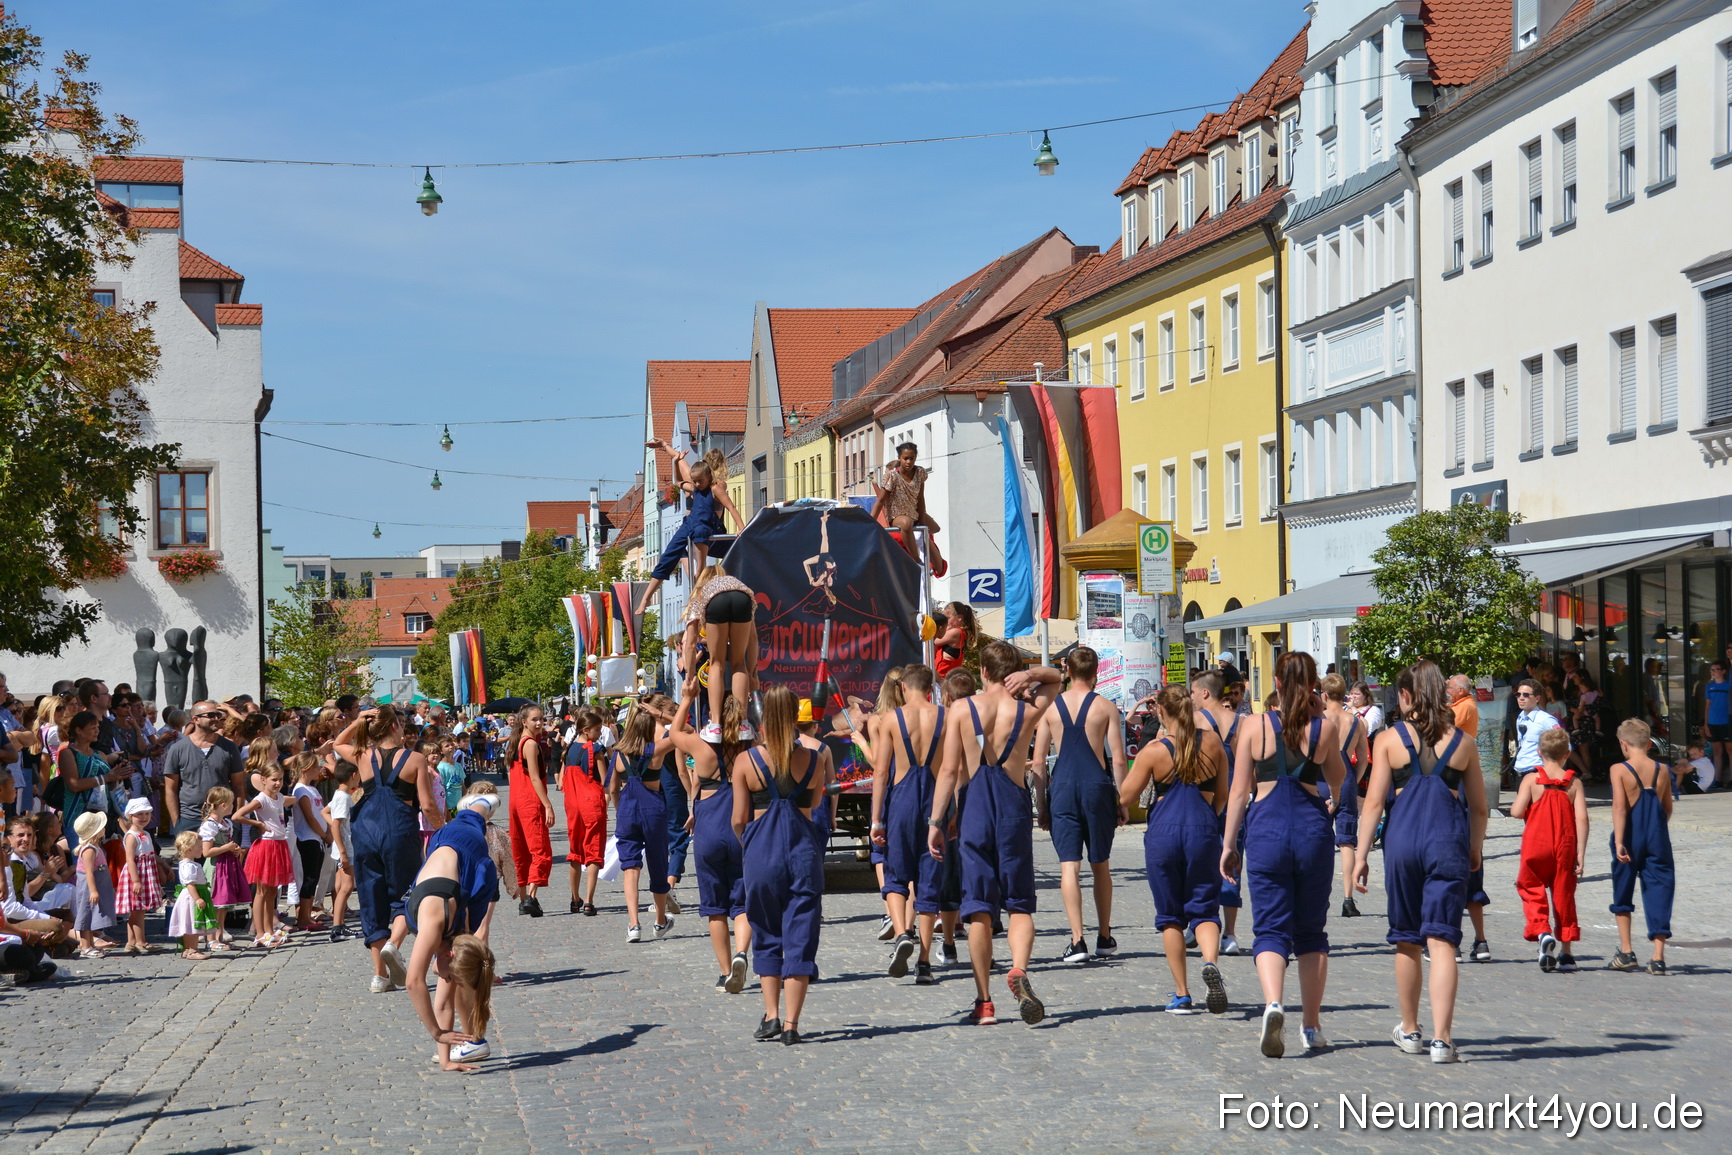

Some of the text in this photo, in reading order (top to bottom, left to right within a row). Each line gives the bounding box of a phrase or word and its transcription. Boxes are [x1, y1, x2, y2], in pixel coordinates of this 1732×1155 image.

[1358, 333, 1384, 362] WEBER
[1148, 532, 1162, 548] H
[832, 664, 852, 673] e.V.
